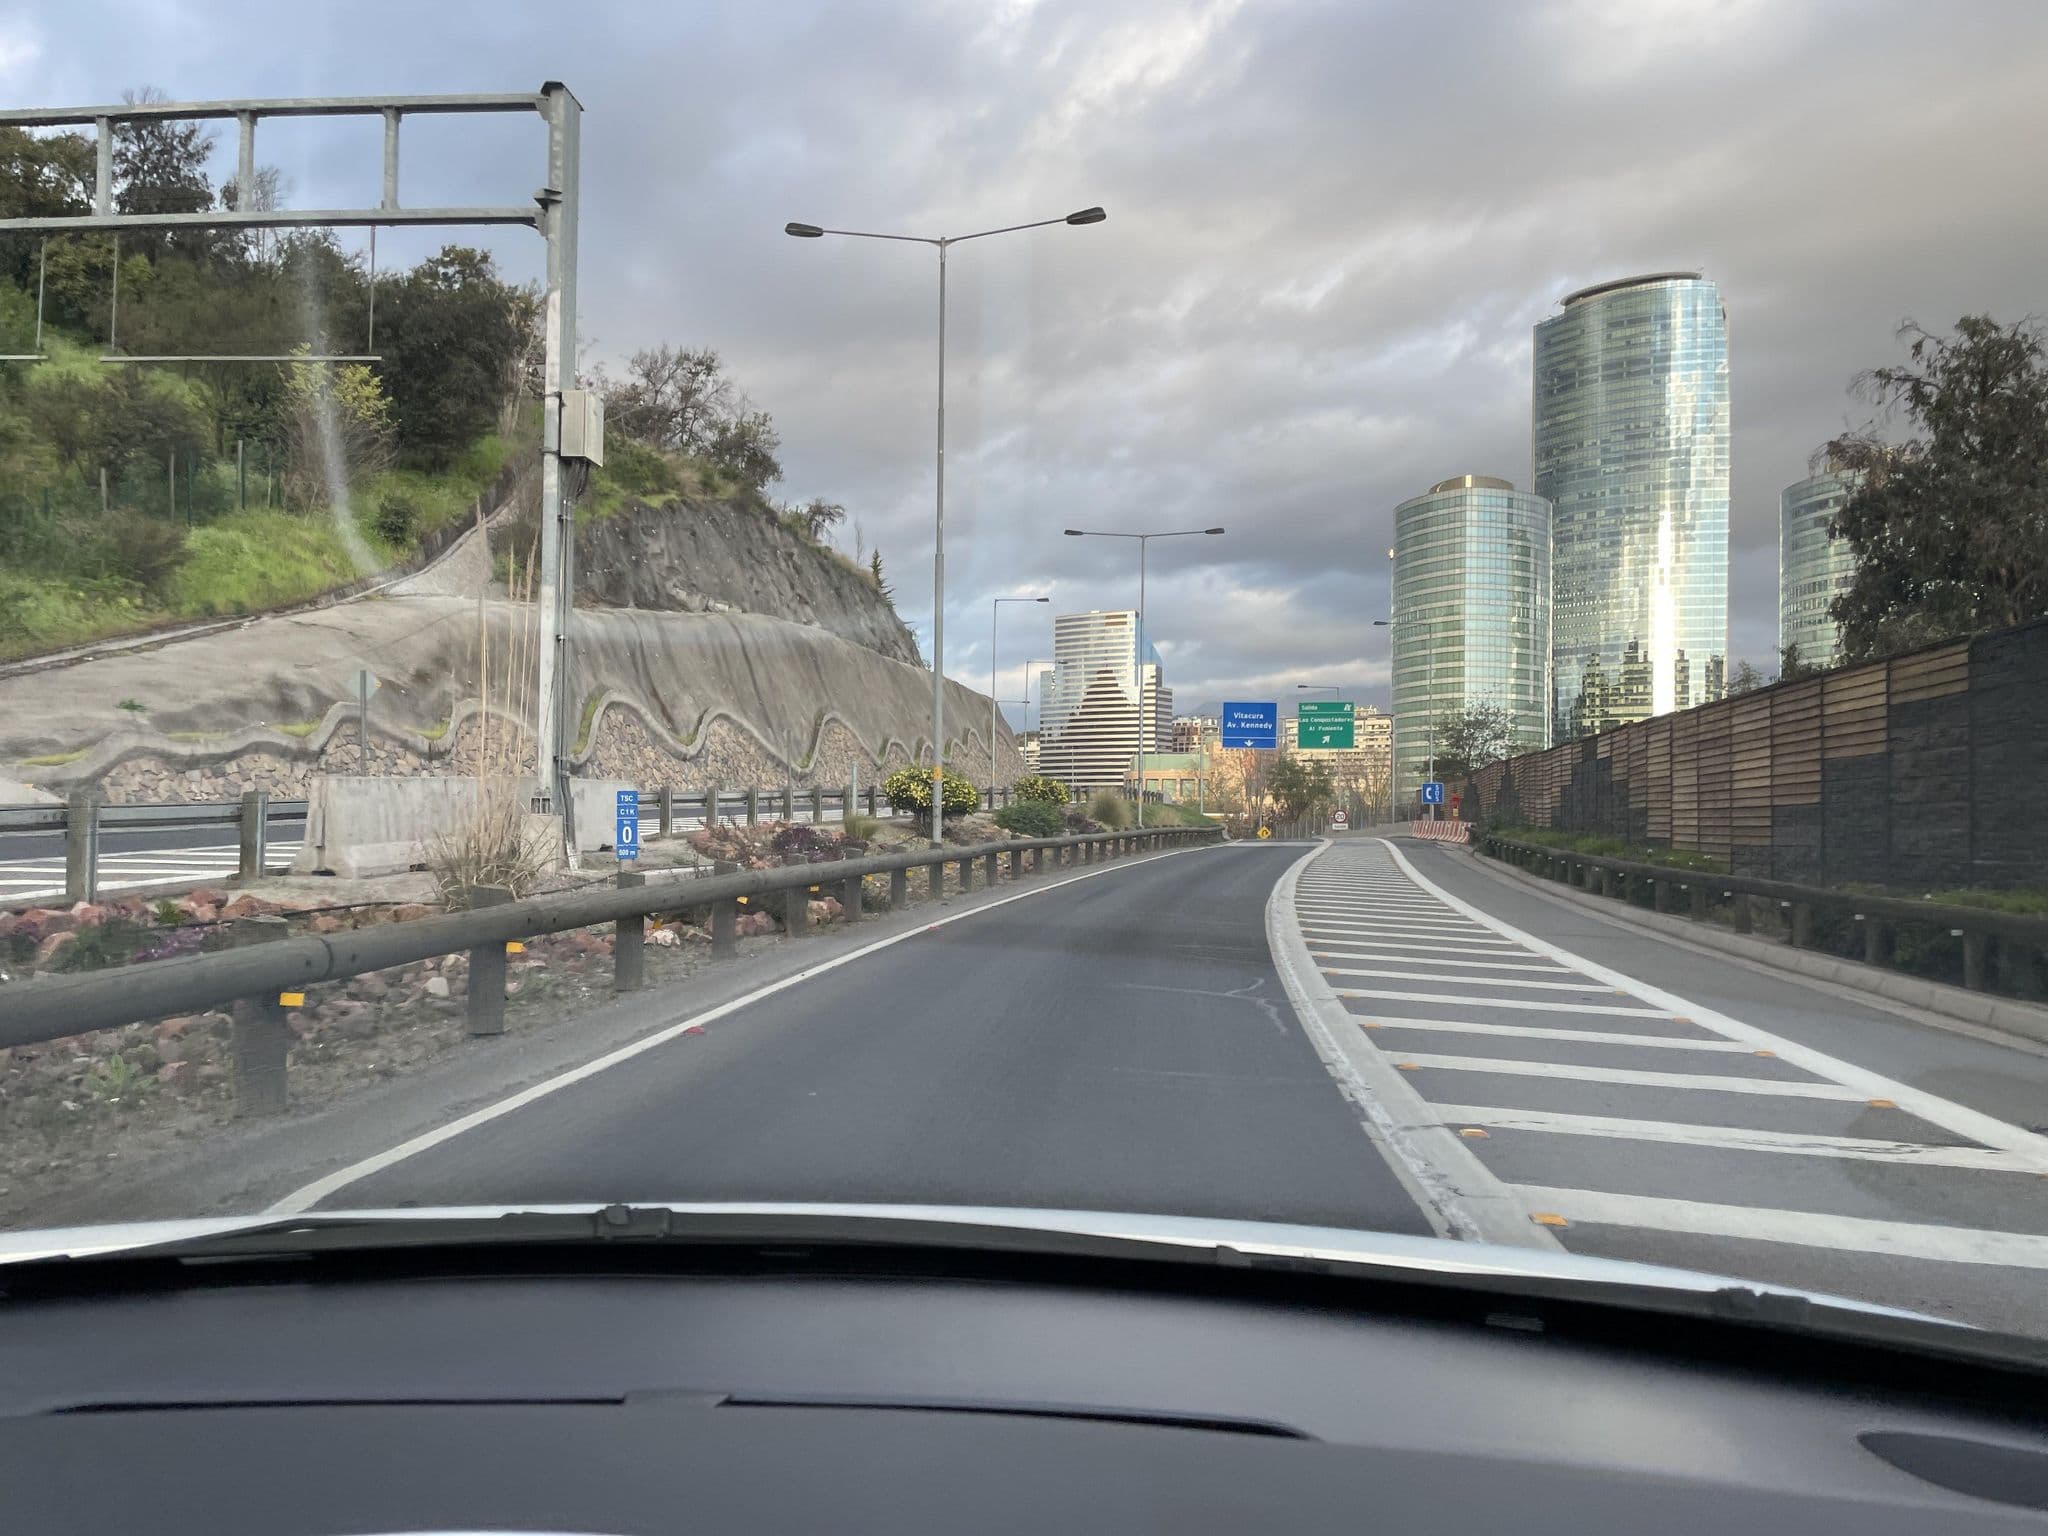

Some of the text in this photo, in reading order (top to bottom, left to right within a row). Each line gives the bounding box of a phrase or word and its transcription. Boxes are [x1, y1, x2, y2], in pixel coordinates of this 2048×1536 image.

[1227, 721, 1273, 730] Av. Kennedy
[622, 826, 633, 844] 0
